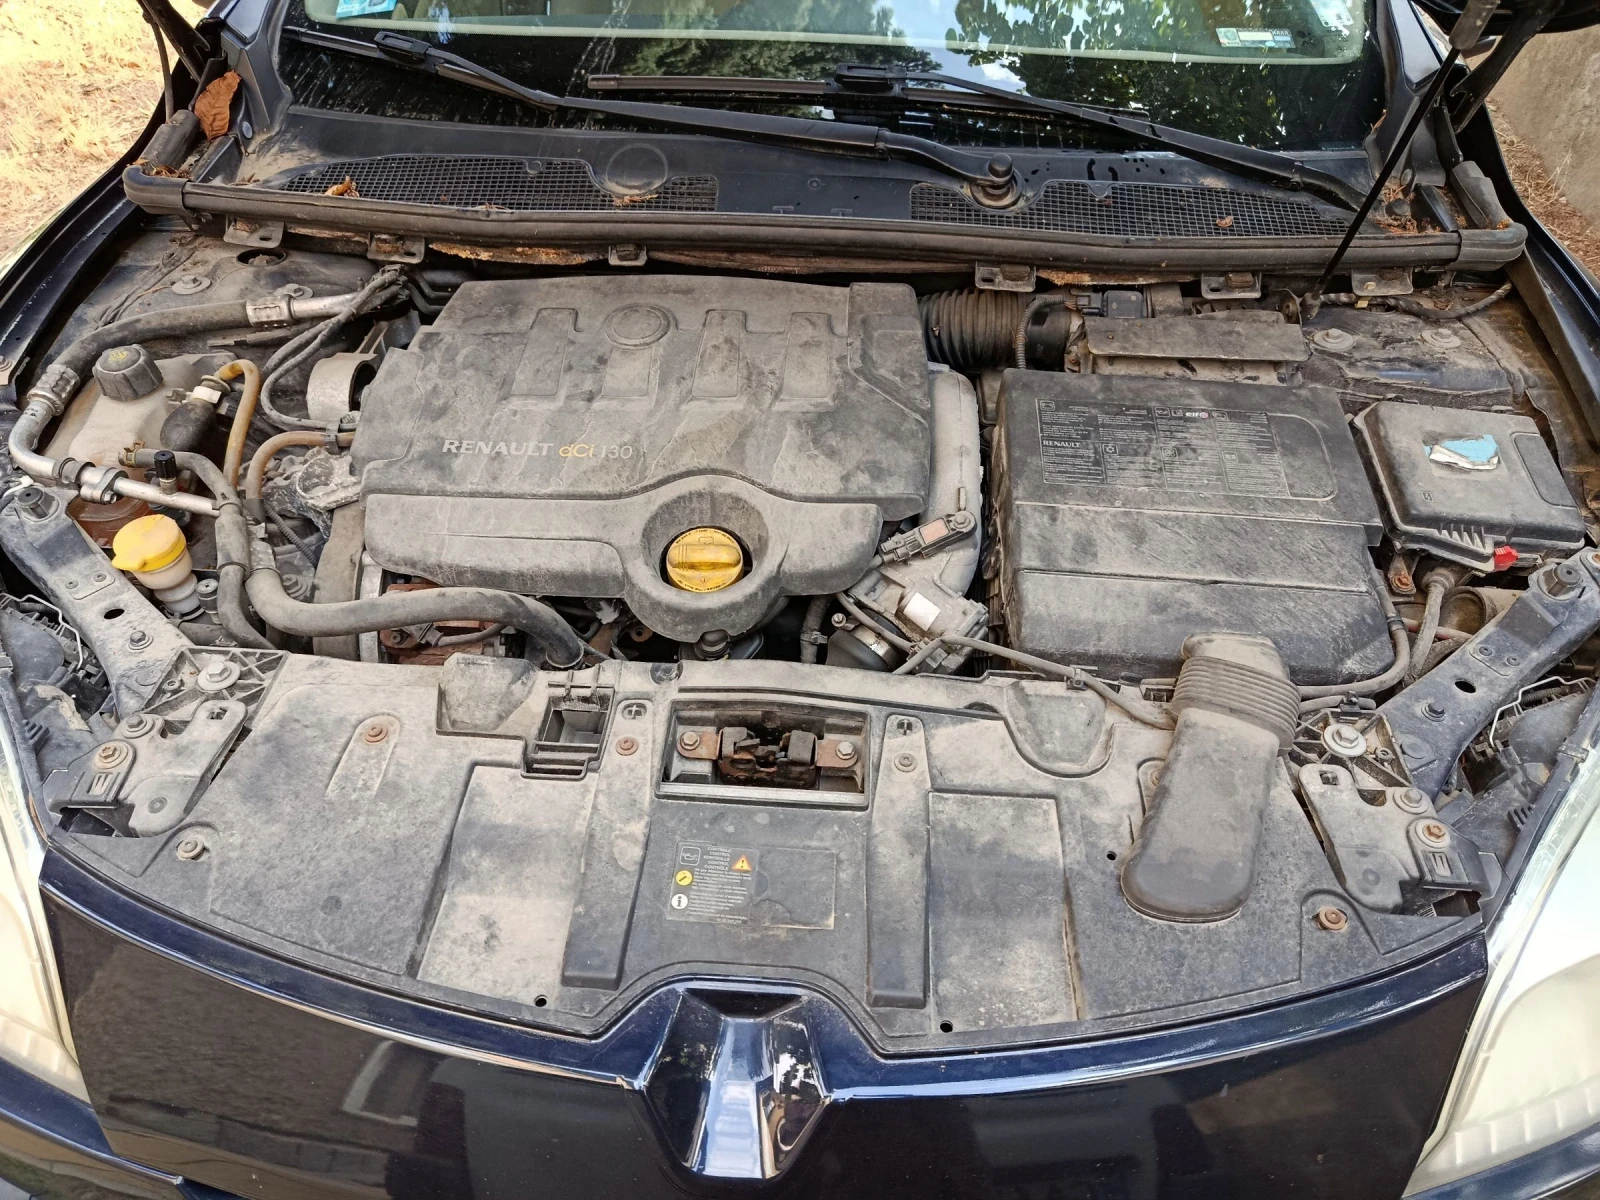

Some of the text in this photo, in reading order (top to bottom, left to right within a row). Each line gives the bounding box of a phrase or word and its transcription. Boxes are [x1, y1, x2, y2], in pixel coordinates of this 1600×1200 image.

[442, 439, 633, 459] RENAULT dCi 130
[1042, 440, 1081, 448] RENAULT
